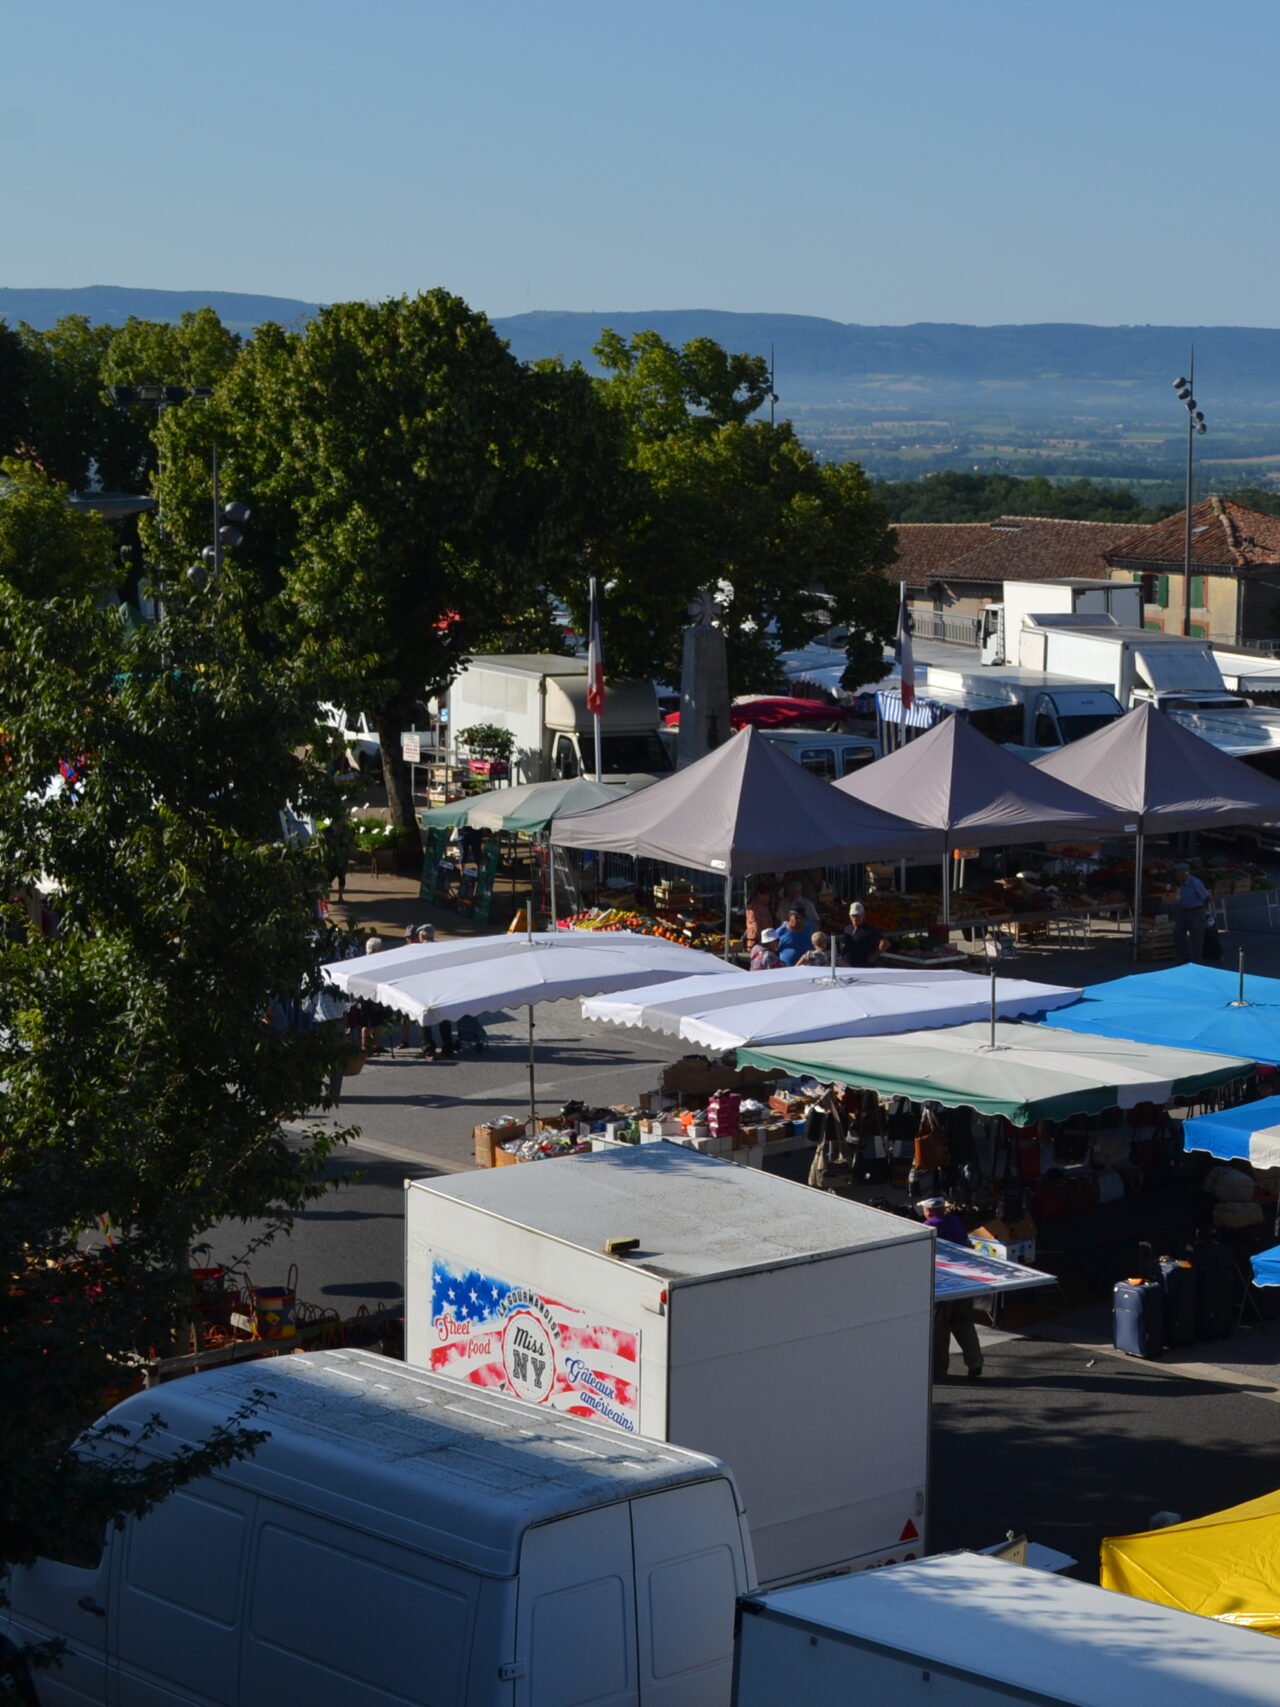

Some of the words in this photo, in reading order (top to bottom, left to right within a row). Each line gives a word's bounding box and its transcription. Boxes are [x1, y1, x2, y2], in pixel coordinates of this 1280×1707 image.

[435, 1312, 471, 1342] Street
[497, 1302, 507, 1317] LA
[507, 1291, 561, 1340] GOURMANDISE
[467, 1337, 491, 1359] food
[513, 1326, 545, 1356] Miss
[513, 1349, 546, 1389] NY
[565, 1356, 615, 1399] Gâteaux
[580, 1391, 634, 1432] américains
